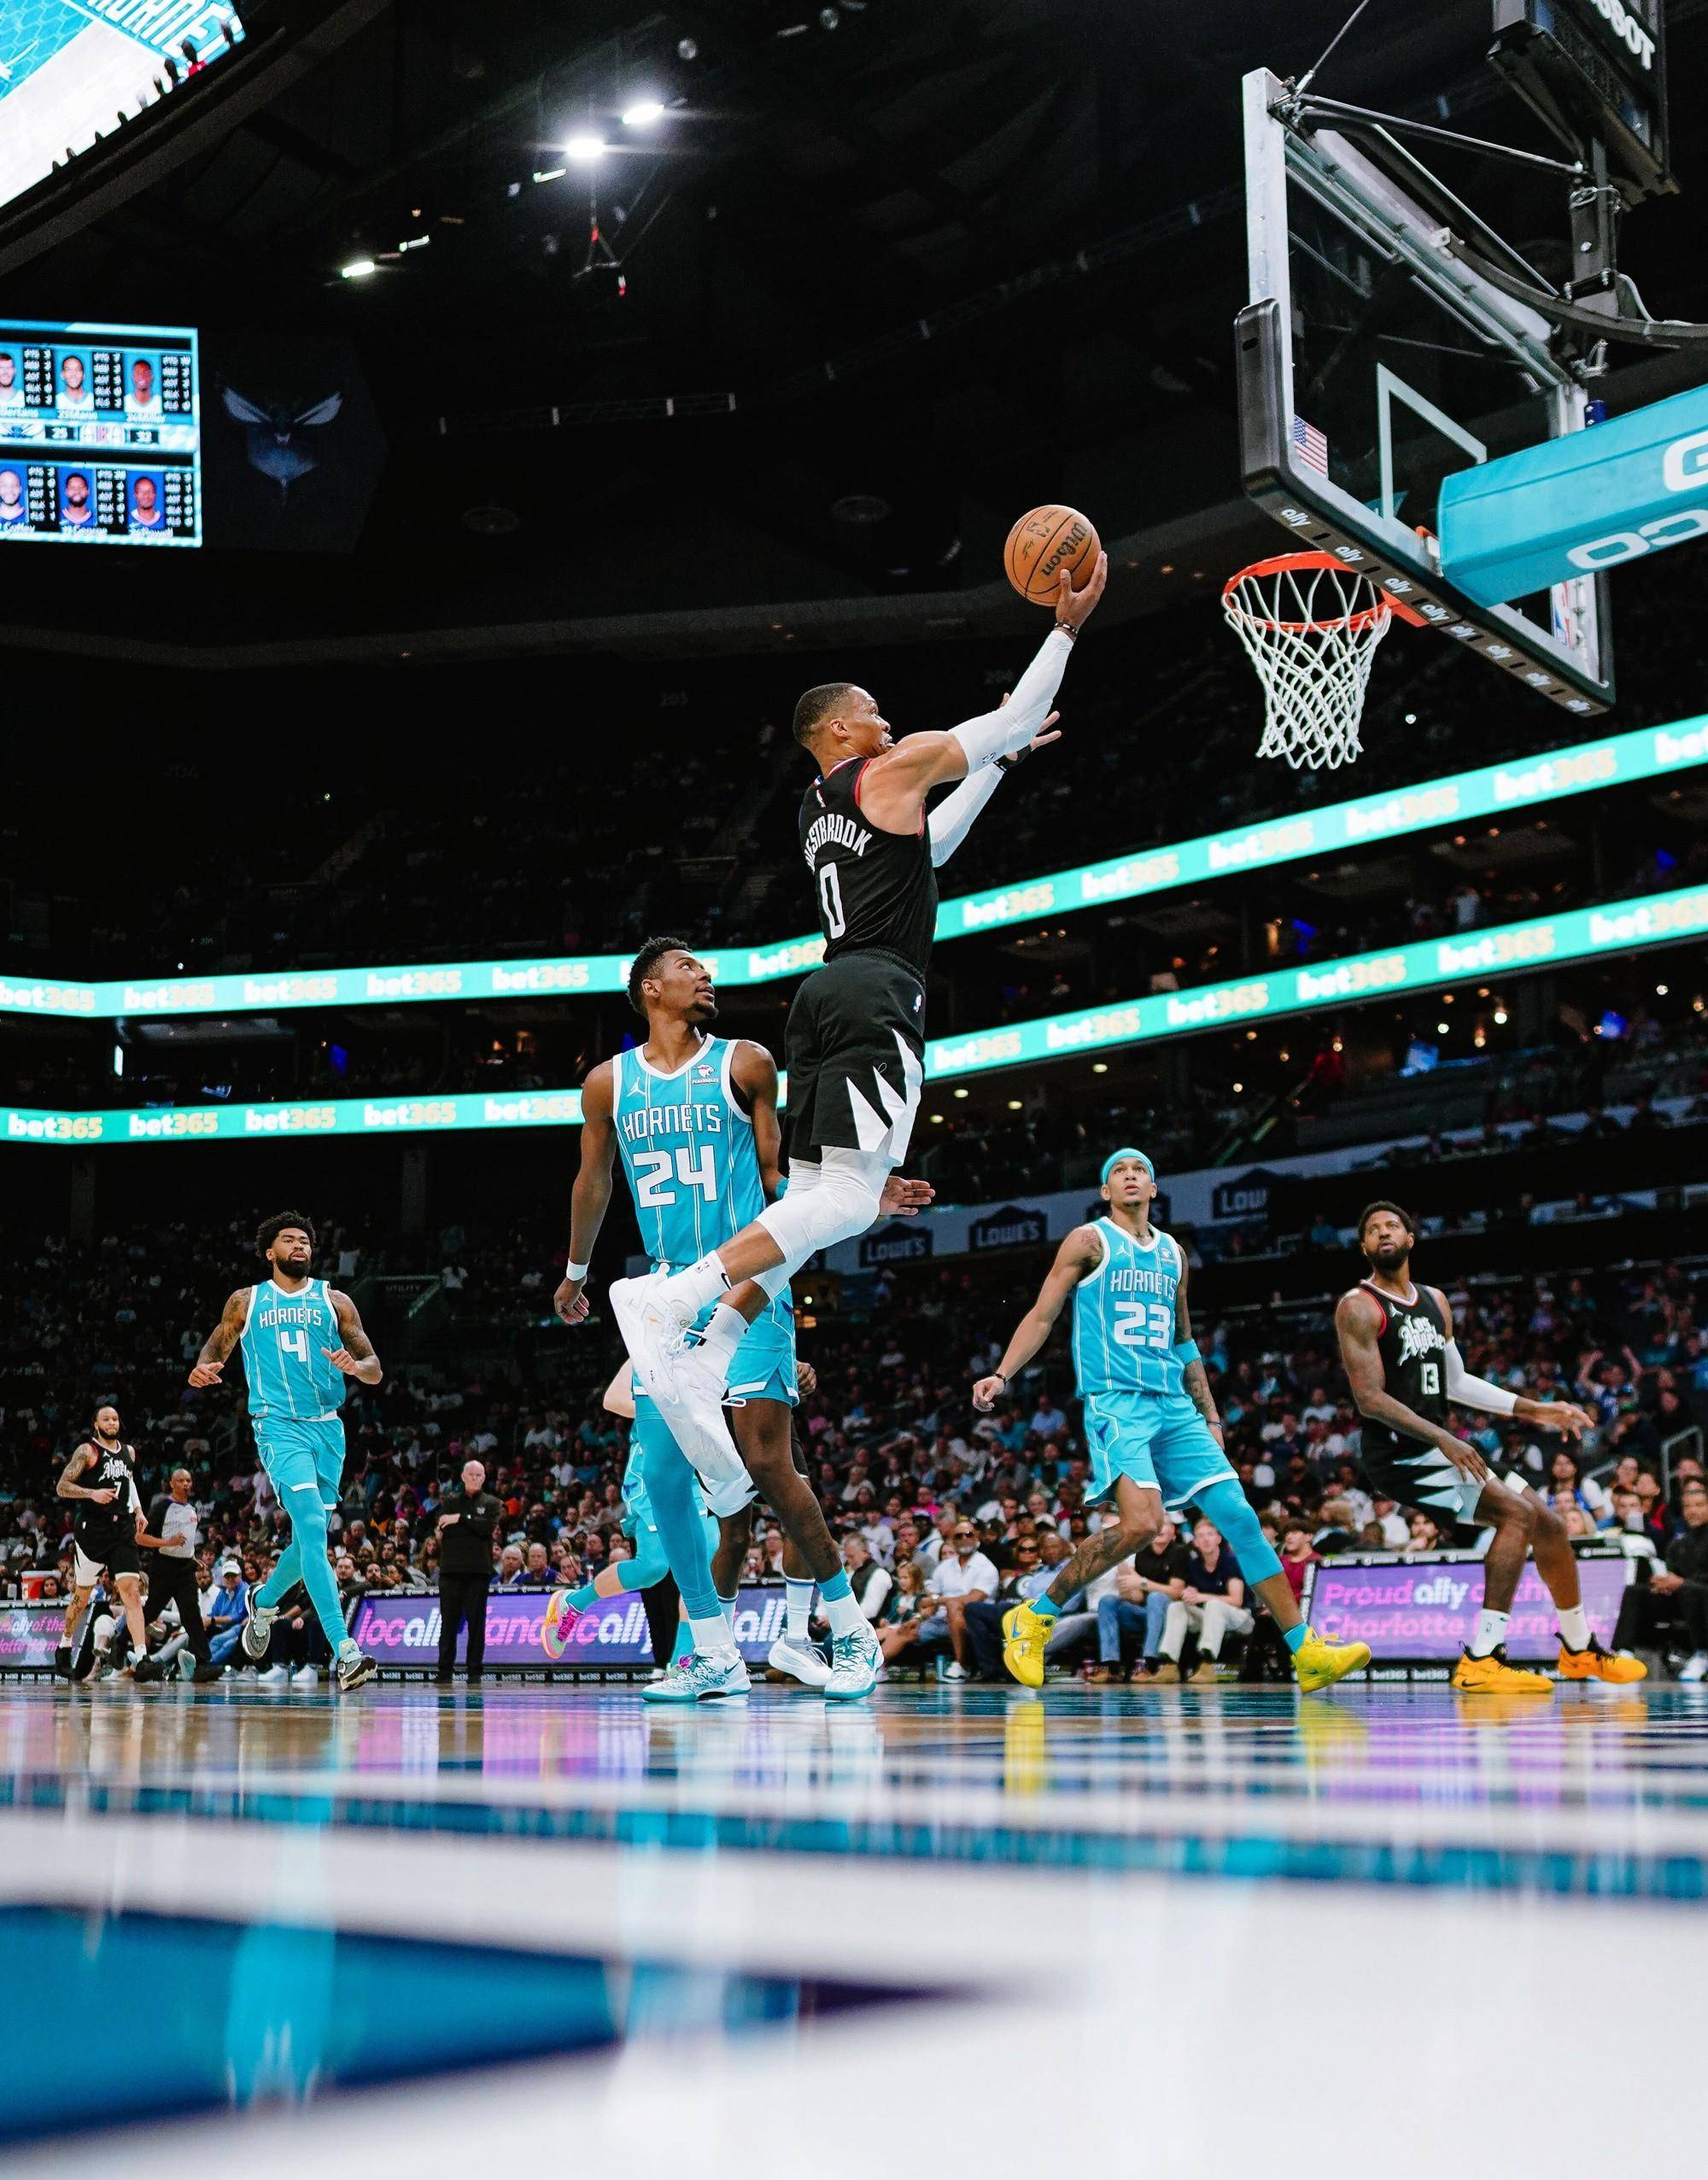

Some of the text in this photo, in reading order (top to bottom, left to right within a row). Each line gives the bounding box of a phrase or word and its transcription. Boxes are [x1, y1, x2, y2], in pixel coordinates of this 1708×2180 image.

[1281, 508, 1312, 527] ally
[1335, 546, 1364, 562] ally
[1383, 577, 1413, 593] ally
[1420, 604, 1449, 622] ally
[1494, 748, 1617, 803] bet365
[1346, 786, 1459, 838] bet365
[1208, 821, 1313, 869] bet365
[1082, 854, 1179, 899] bet365
[819, 862, 846, 939] 0
[962, 884, 1054, 927] bet365
[1437, 926, 1555, 974] bet365
[244, 977, 337, 1003] bet365
[367, 970, 462, 996] bet365
[492, 964, 589, 990] bet365
[1297, 956, 1407, 1002] bet365
[0, 983, 95, 1011] bet365
[124, 981, 215, 1009] bet365
[1167, 982, 1268, 1025] bet365
[1047, 1008, 1141, 1049] bet365
[935, 1032, 1021, 1071] bet365
[245, 1108, 336, 1131] bet365
[364, 1103, 456, 1126] bet365
[484, 1096, 578, 1121] bet365
[9, 1113, 103, 1139] bet365
[129, 1112, 218, 1137] bet365
[623, 1104, 723, 1143] HORNETS
[633, 1144, 718, 1208] 24
[981, 1221, 1040, 1247] LOWE'S
[867, 1237, 926, 1262] LOWE'S
[1110, 1269, 1177, 1301] HORNETS
[259, 1307, 322, 1329] HORNETS
[1114, 1300, 1171, 1350] 23
[280, 1330, 307, 1362] 4
[1421, 1363, 1441, 1394] 13
[114, 1482, 121, 1499] 7
[1325, 1580, 1414, 1605] Proud
[1413, 1576, 1469, 1610] ally
[357, 1608, 442, 1646] locall
[1322, 1612, 1466, 1639] Charlotte
